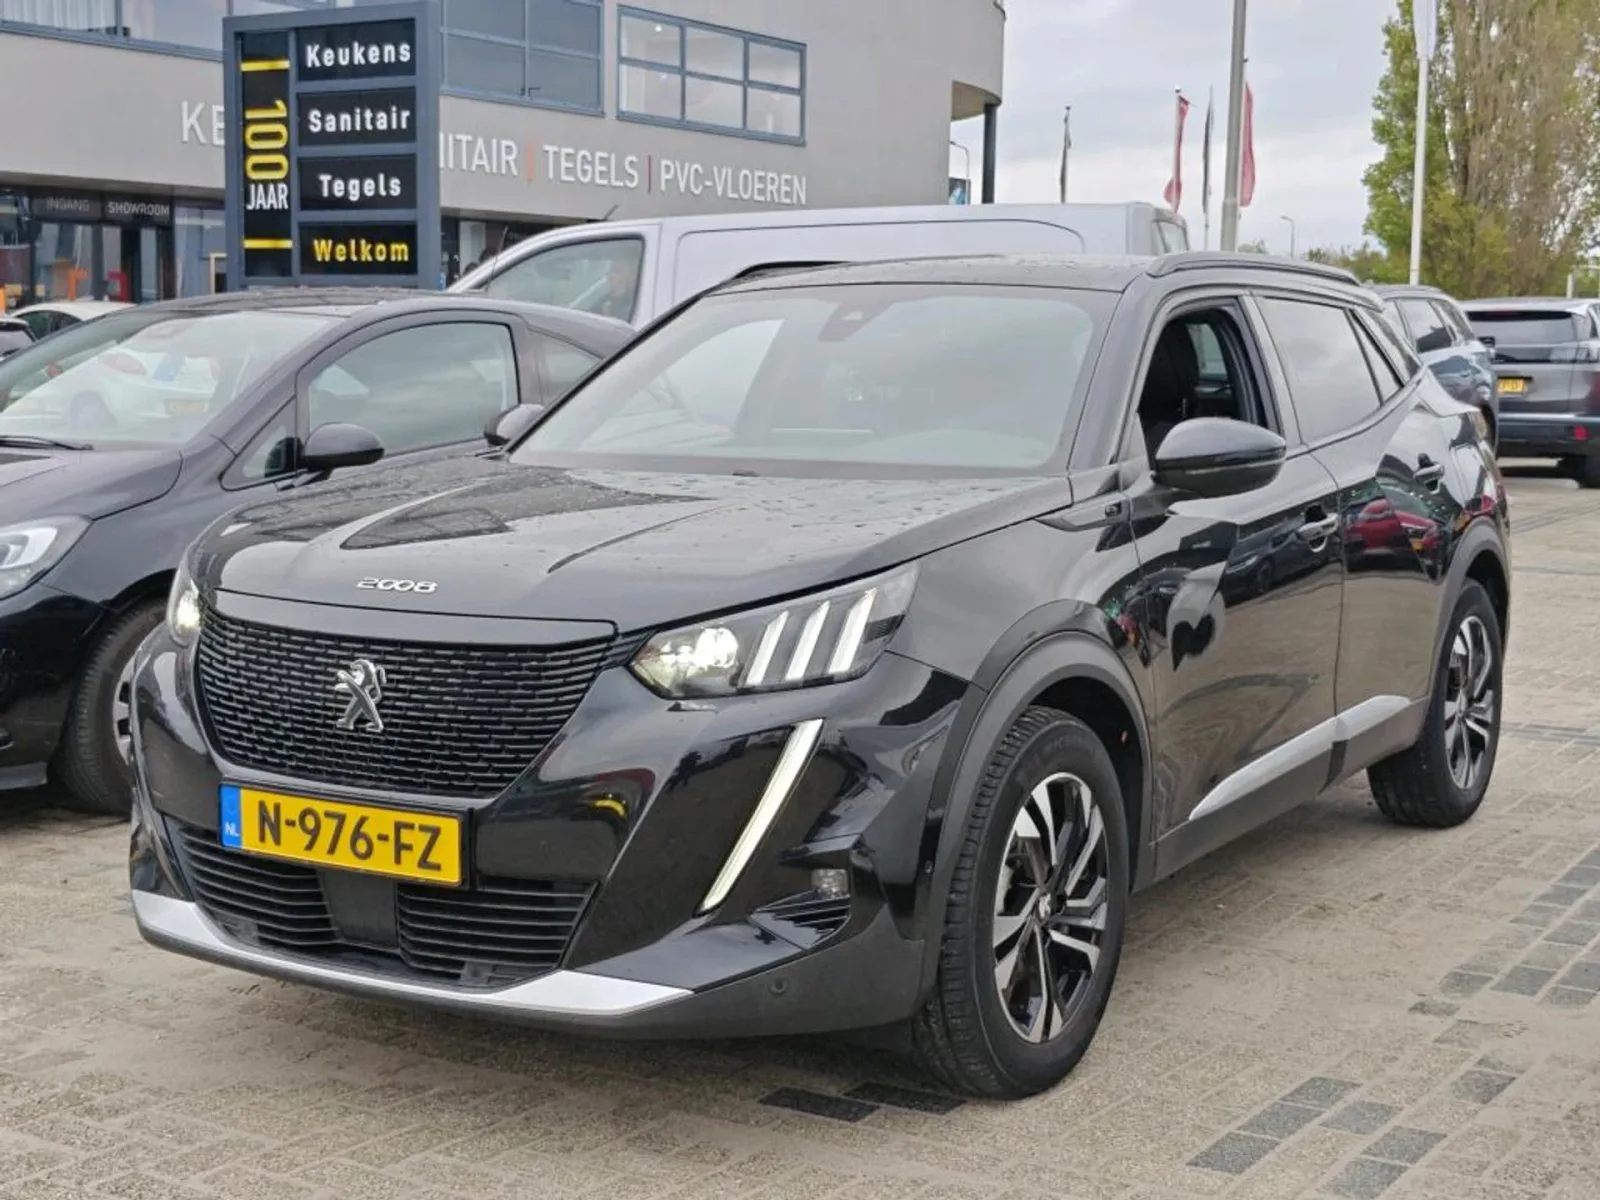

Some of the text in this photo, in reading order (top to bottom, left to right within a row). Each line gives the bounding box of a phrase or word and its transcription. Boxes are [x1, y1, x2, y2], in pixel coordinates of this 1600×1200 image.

[306, 41, 411, 68] Keukens
[308, 105, 411, 133] Sanitair
[244, 99, 289, 180] 100
[318, 172, 402, 202] Tegels
[543, 143, 640, 189] TEGELS
[660, 159, 807, 205] PVC-VLOEREN
[46, 197, 171, 216] INGANG SHOWROOM
[246, 182, 289, 210] JAAR
[313, 239, 409, 262] Welkom
[356, 577, 438, 594] 2008
[225, 799, 442, 873] NL N-976-FZ
